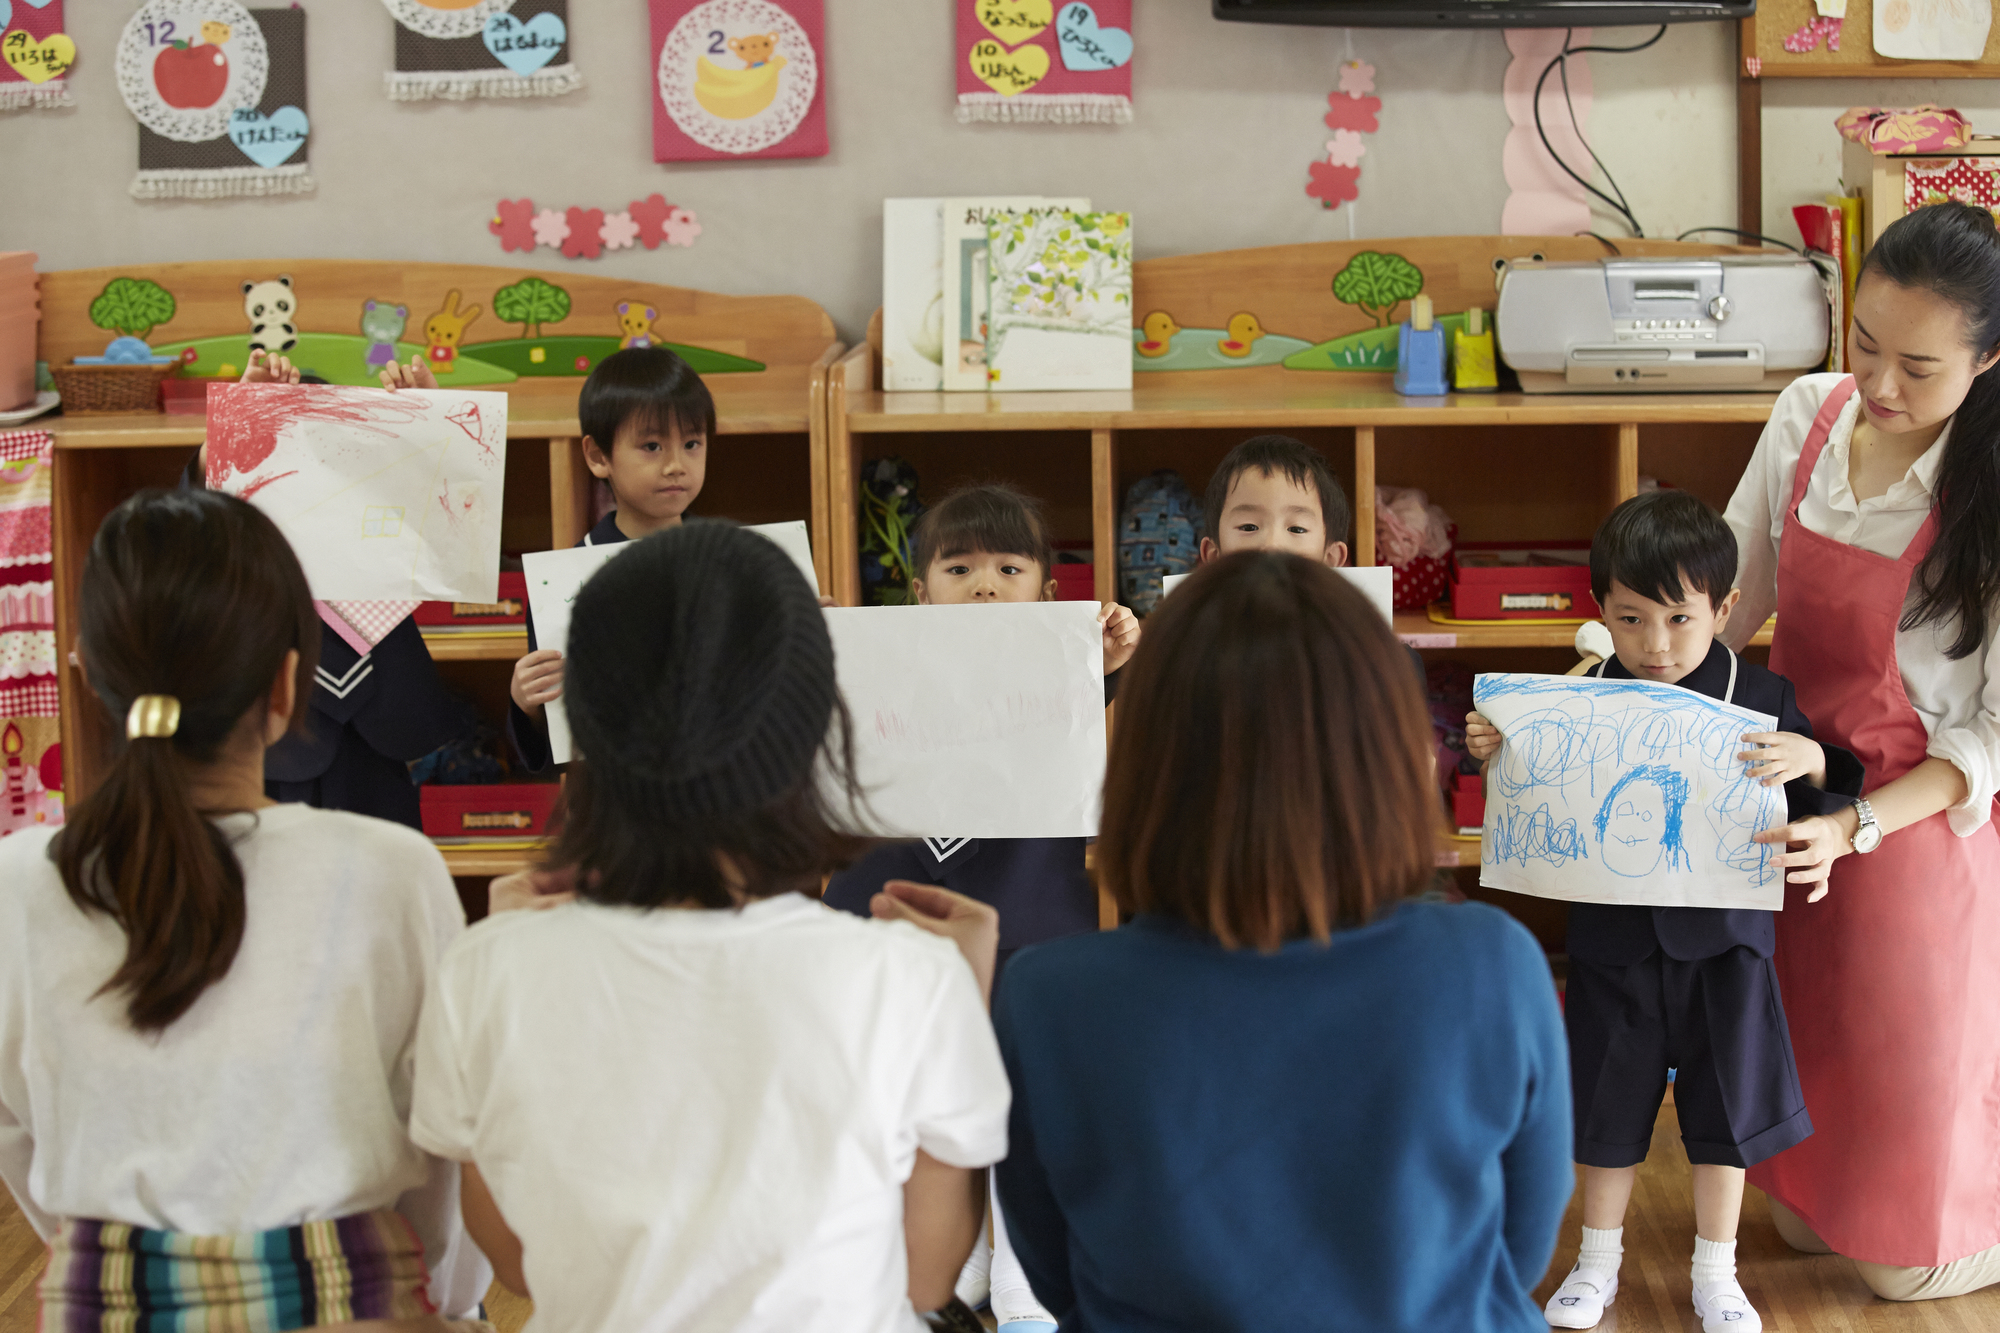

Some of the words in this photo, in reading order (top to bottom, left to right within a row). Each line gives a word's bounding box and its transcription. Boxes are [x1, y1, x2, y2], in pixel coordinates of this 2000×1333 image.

[1069, 6, 1088, 25] 19
[7, 33, 27, 48] 29
[144, 21, 177, 47] 12
[708, 30, 725, 53] 2
[11, 48, 57, 65] いろは
[977, 44, 997, 57] 10
[235, 109, 259, 121] 20
